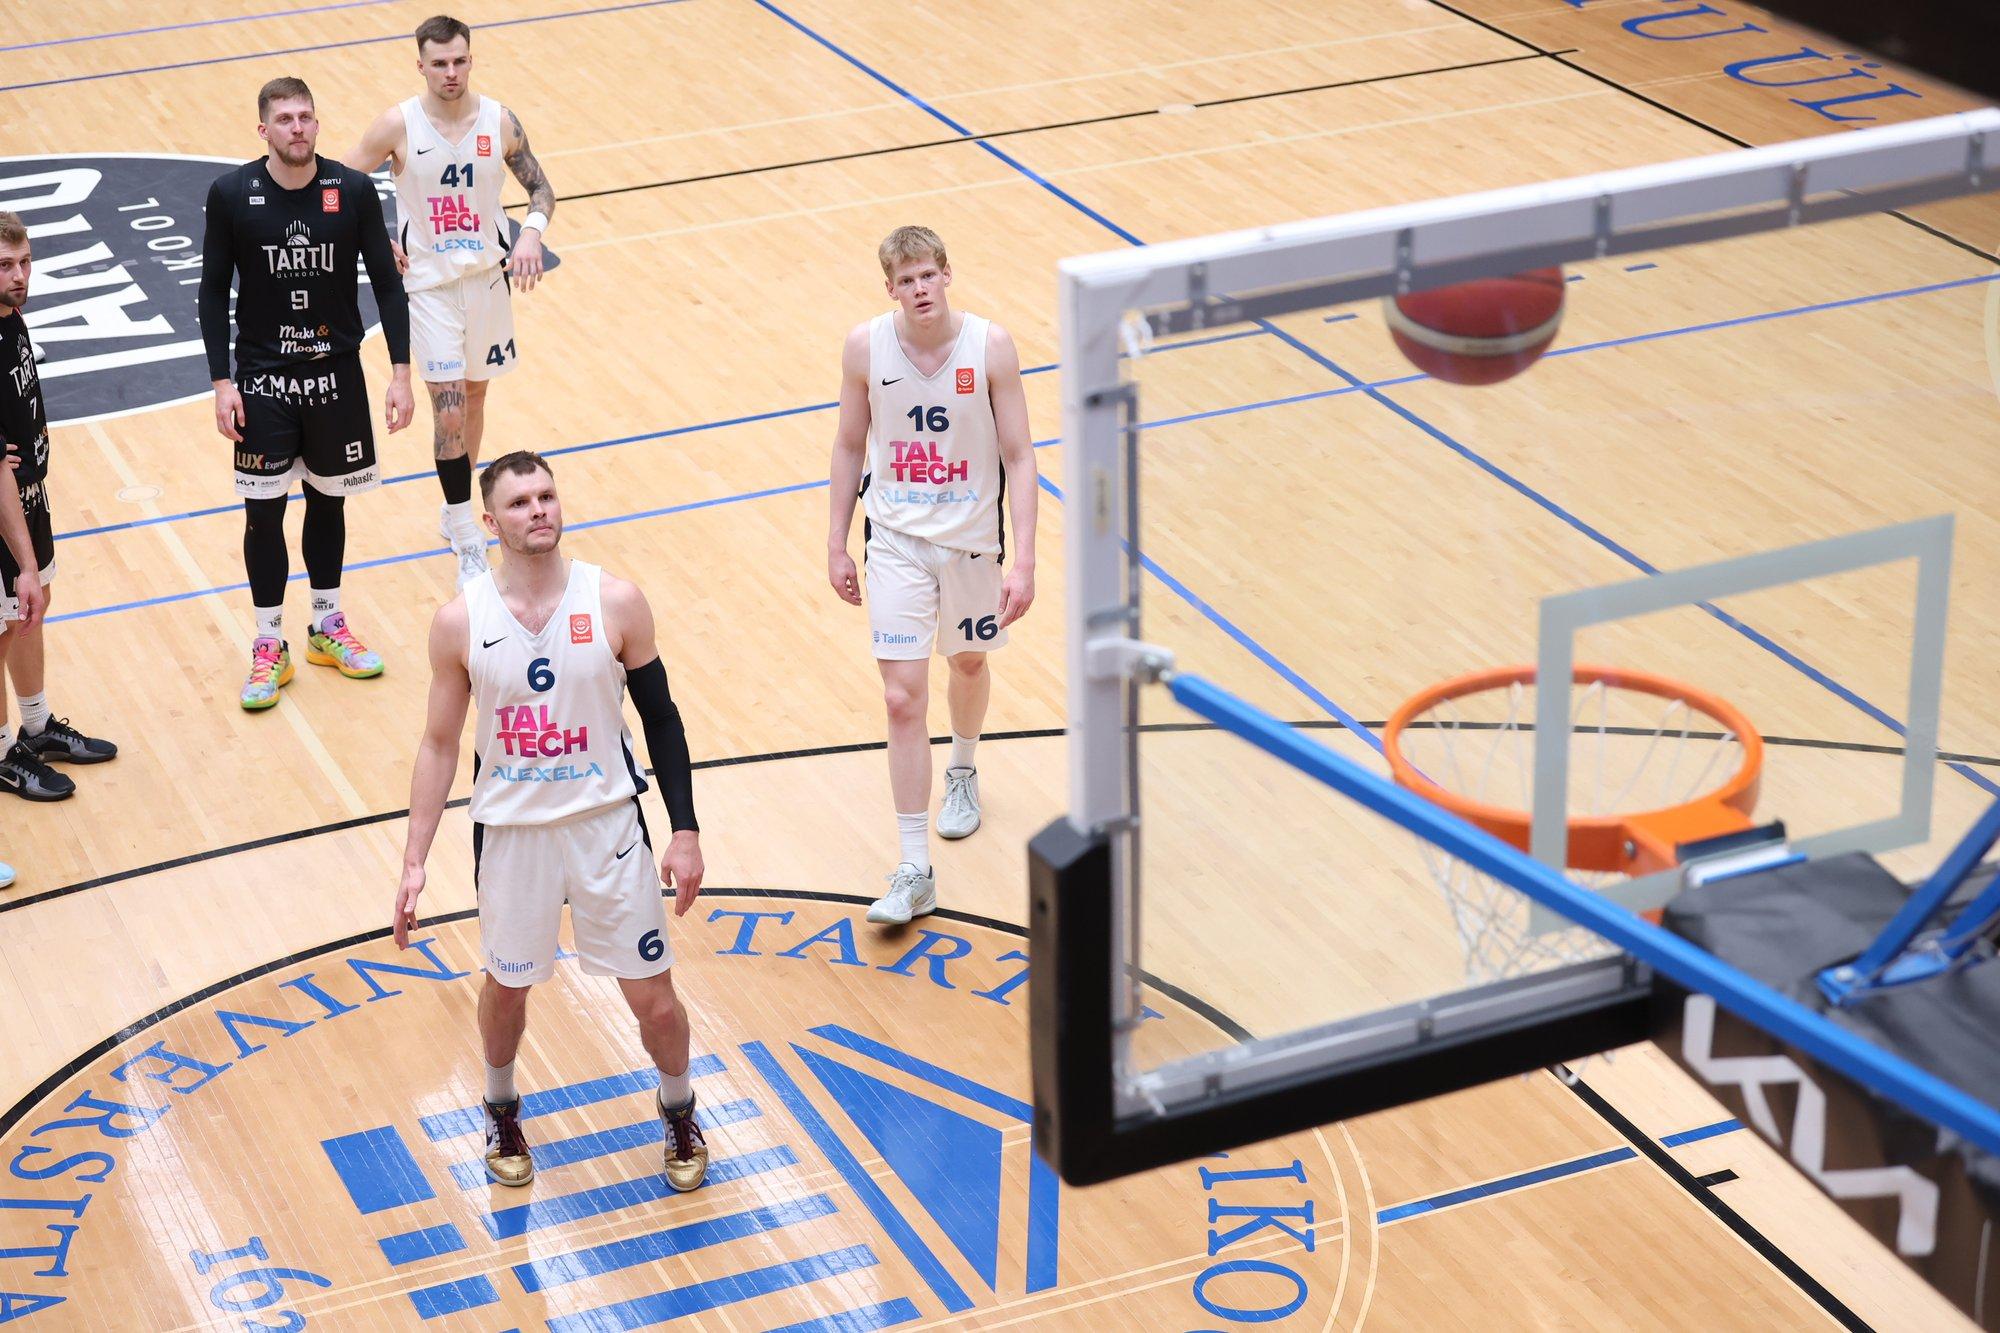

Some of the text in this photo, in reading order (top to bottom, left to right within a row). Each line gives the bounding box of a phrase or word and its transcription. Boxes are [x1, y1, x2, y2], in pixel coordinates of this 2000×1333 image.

[440, 163, 474, 188] 41
[427, 194, 470, 216] TAL
[432, 238, 485, 253] LEXEL
[261, 243, 335, 275] TARTU
[279, 325, 329, 340] Maks &
[280, 340, 331, 355] Moorits
[486, 338, 516, 366] 41
[269, 372, 337, 397] MAPRI
[30, 396, 37, 420] 7
[275, 391, 339, 407] ehitus
[907, 405, 950, 432] 16
[236, 451, 289, 470] LUX Express
[889, 441, 944, 463] TAL
[890, 460, 968, 485] TECH
[882, 633, 917, 644] Tallinn
[957, 614, 998, 641] 16
[527, 657, 555, 693] 6
[495, 704, 558, 732] TAL
[496, 726, 589, 759] TECH
[490, 761, 604, 783] ALEXELA
[637, 929, 664, 962] 6
[495, 957, 534, 973] Tallinn
